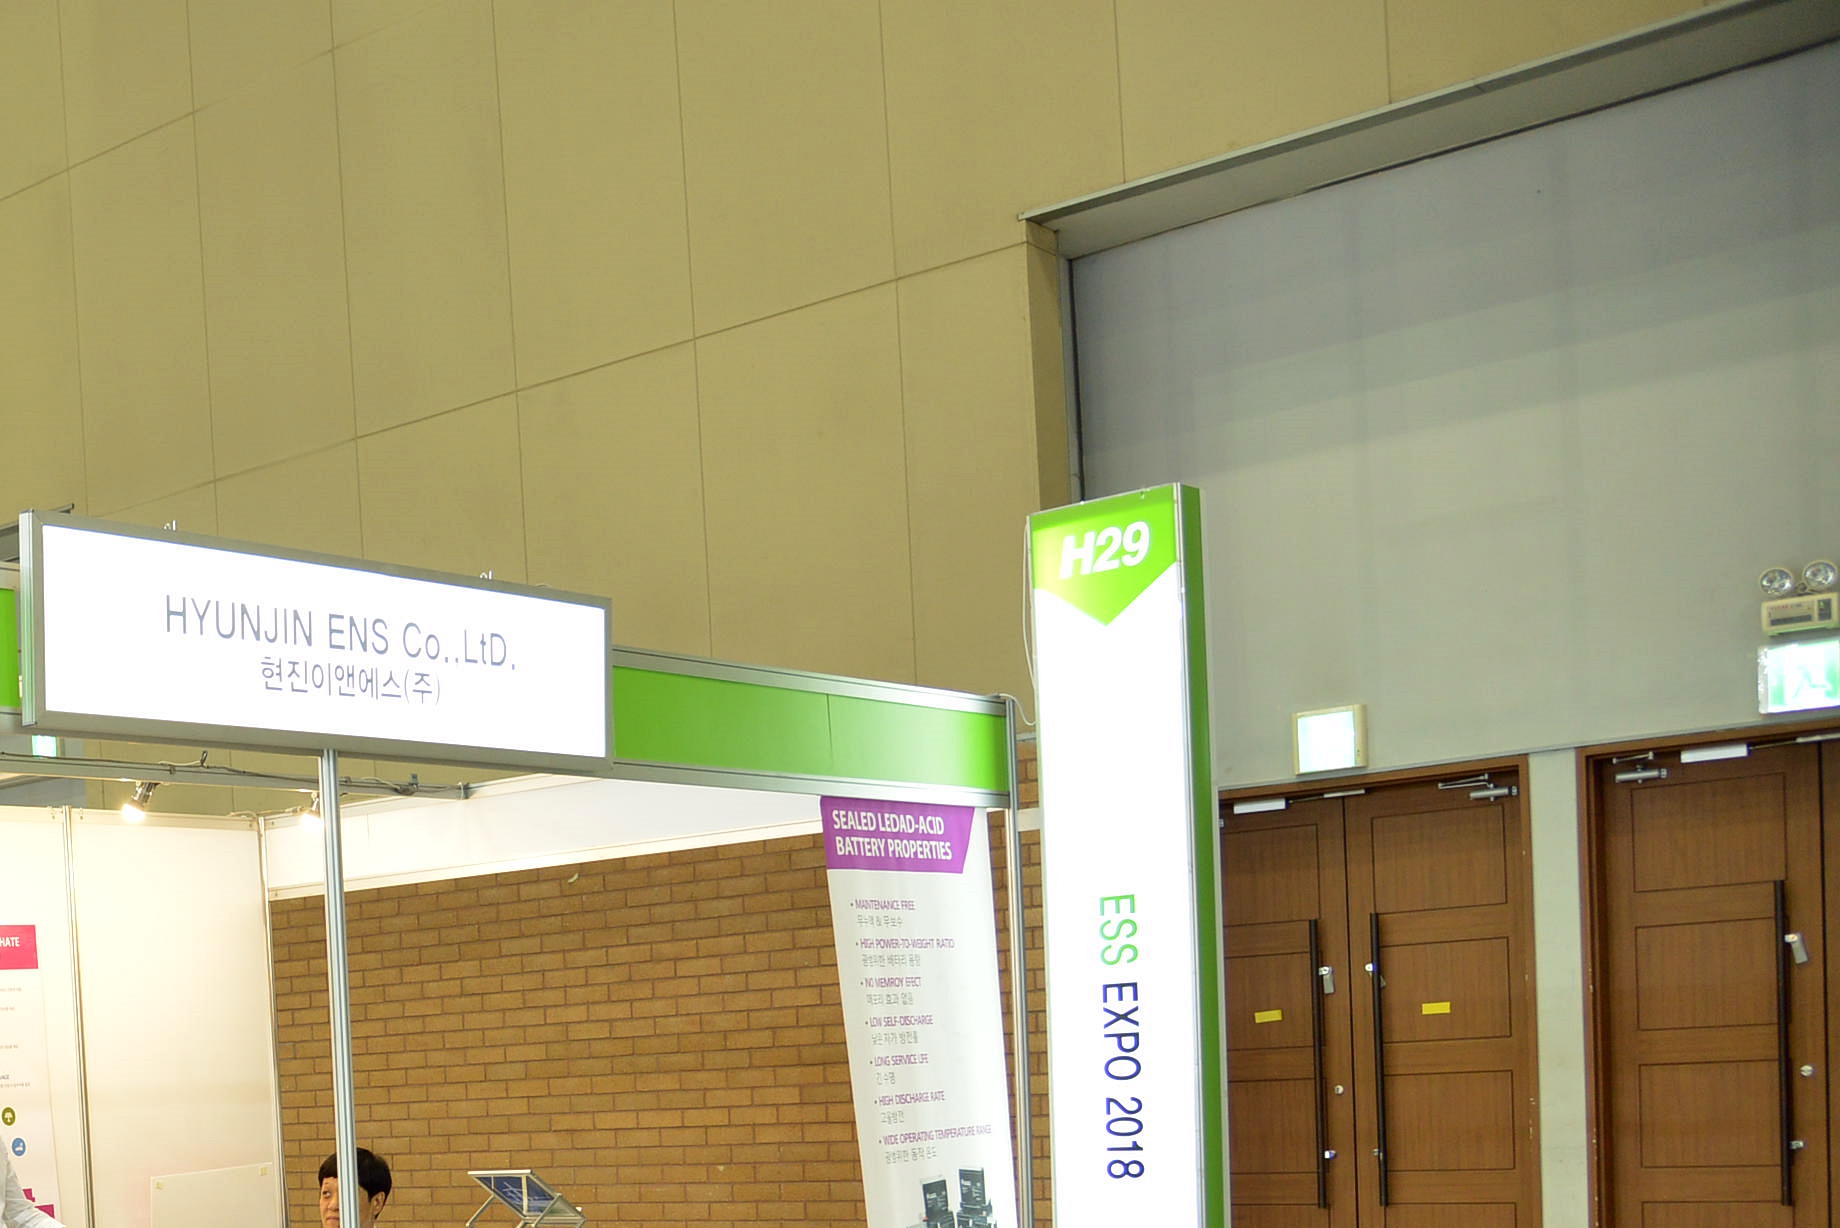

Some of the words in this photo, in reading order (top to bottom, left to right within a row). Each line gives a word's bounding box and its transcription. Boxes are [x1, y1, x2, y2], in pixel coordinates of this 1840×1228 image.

[1059, 520, 1150, 580] H29
[165, 595, 313, 648] HYUNJIN
[328, 613, 389, 656] ENS
[260, 656, 441, 706] 현진이앤에스(주)
[832, 809, 876, 831] SEALED
[878, 813, 944, 835] LEDAD-ACID
[835, 836, 885, 857] BATTERY
[887, 838, 952, 860] PROPERTIES
[1099, 894, 1139, 965] ESS
[1102, 982, 1142, 1080] EXPO
[1105, 1097, 1145, 1179] 2018
